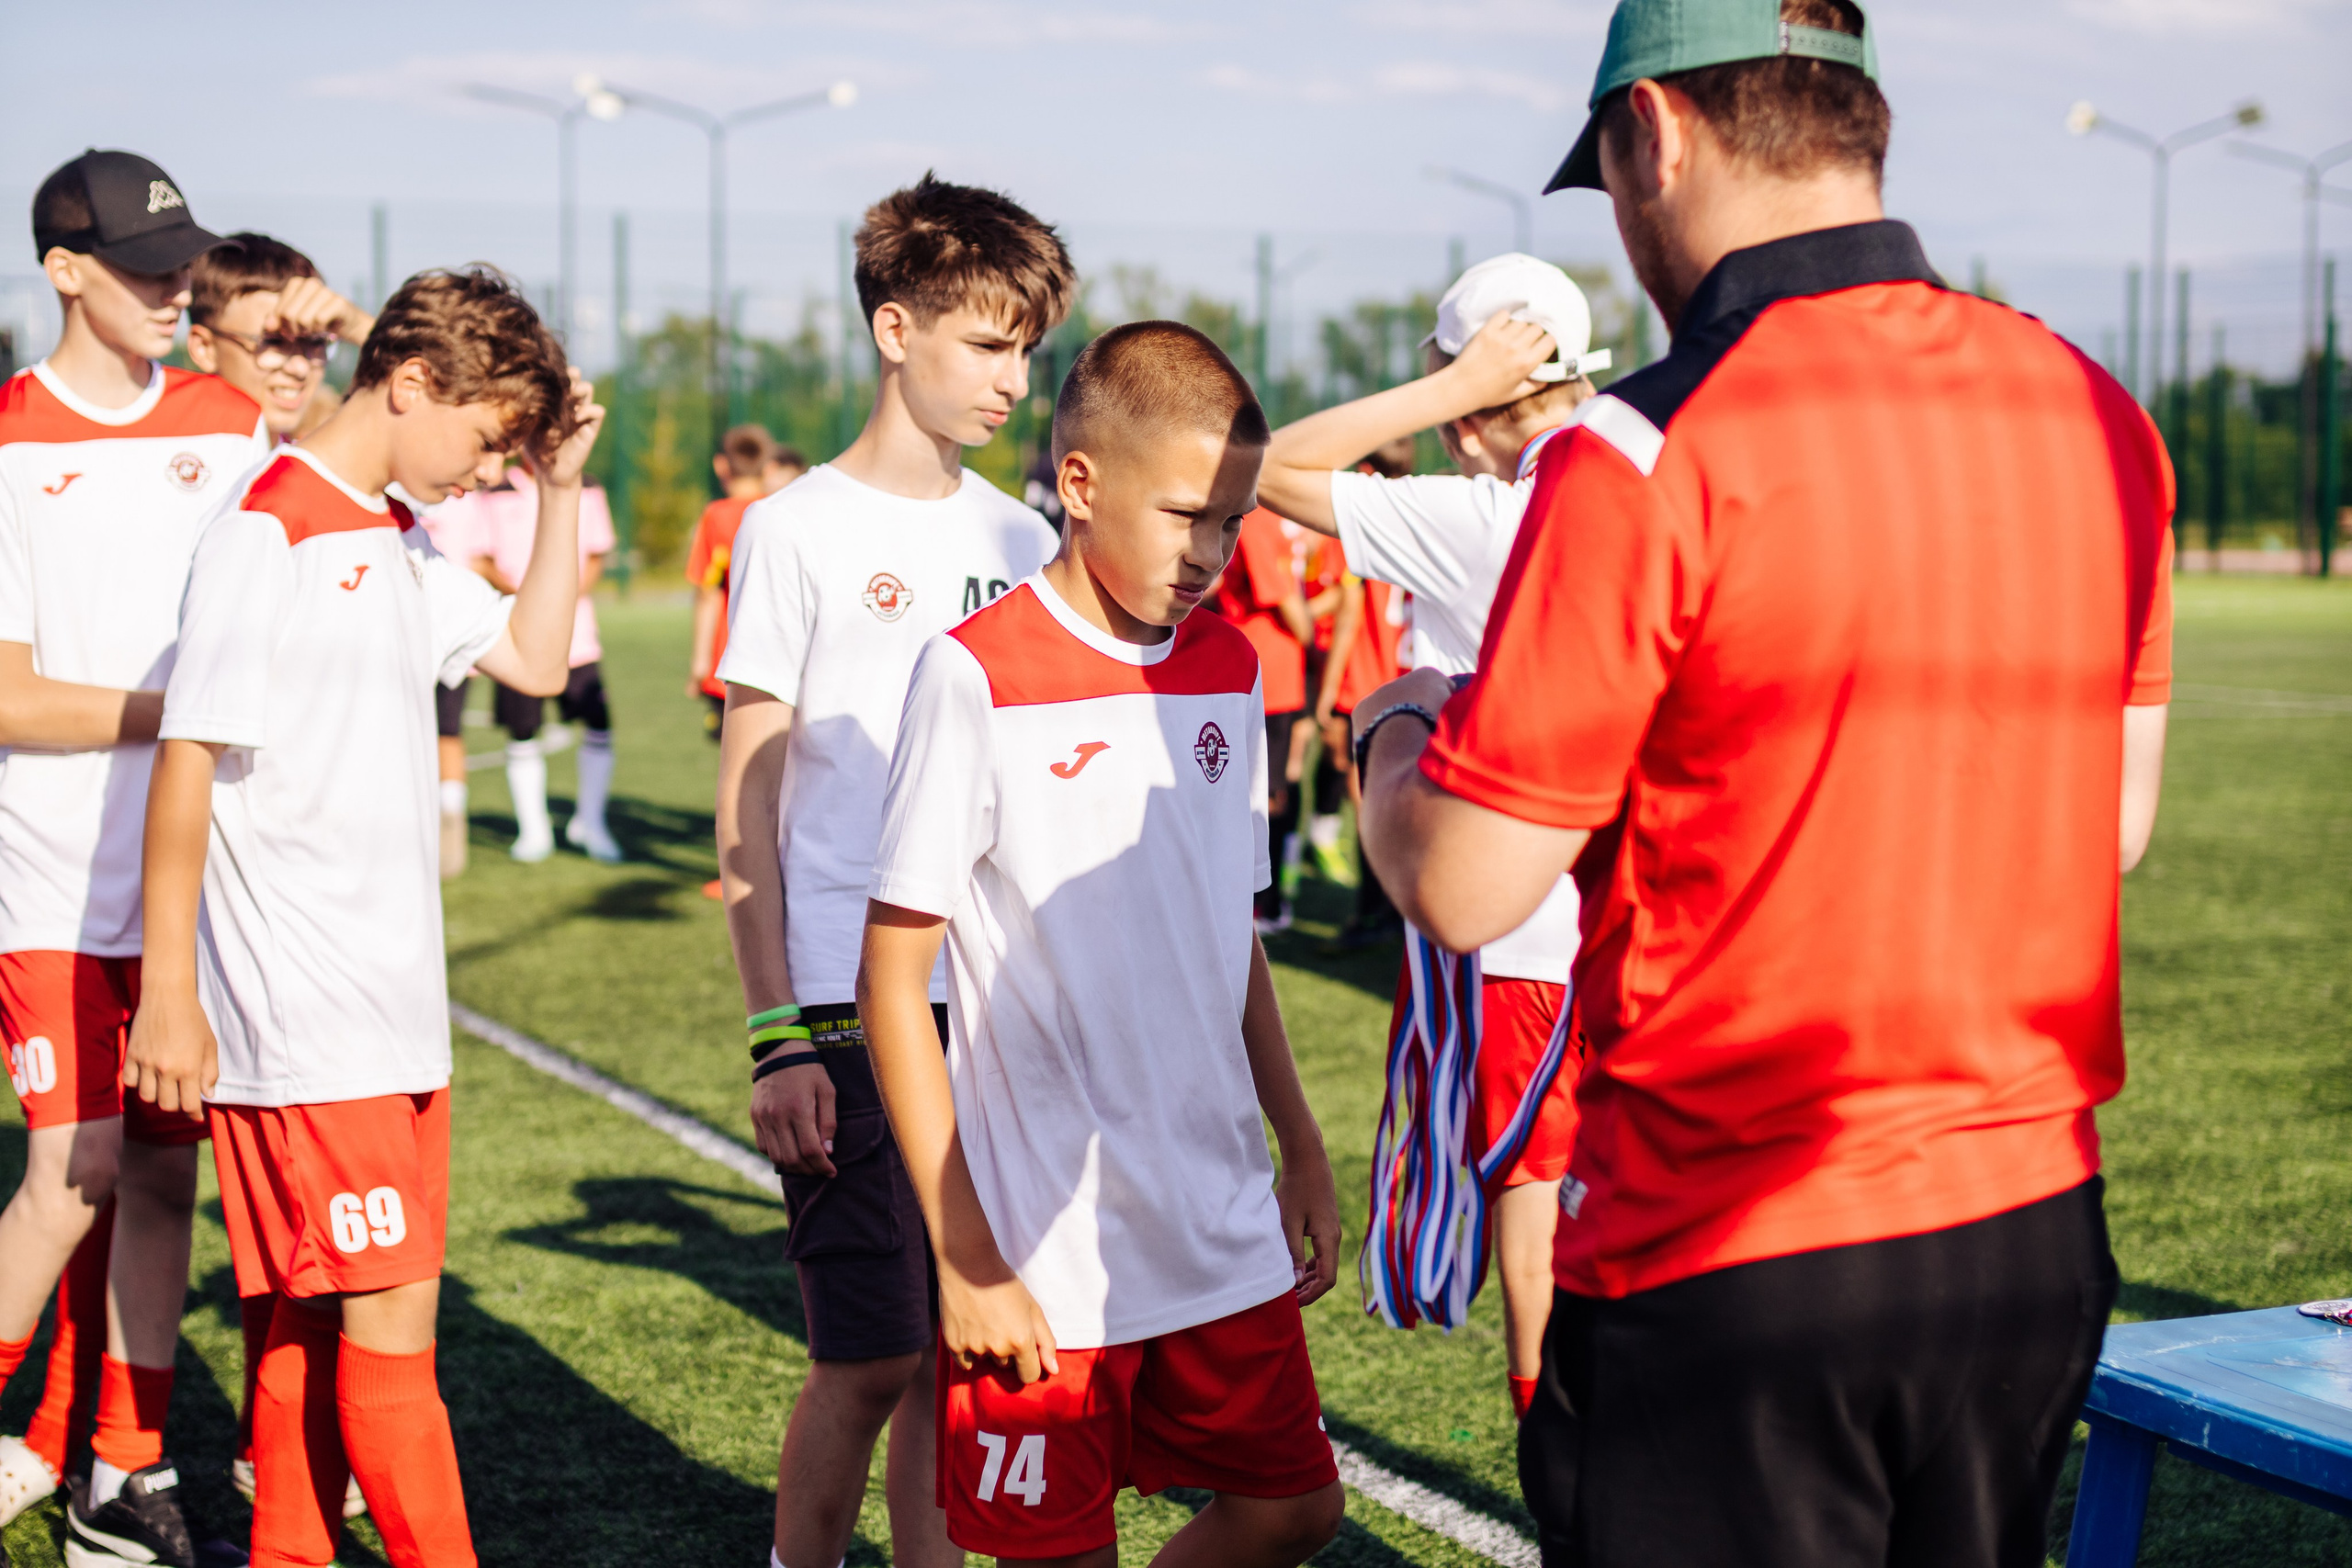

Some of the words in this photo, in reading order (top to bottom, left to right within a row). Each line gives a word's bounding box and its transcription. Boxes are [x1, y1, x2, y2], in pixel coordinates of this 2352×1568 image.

[810, 1021, 832, 1032] SURF
[11, 1035, 58, 1098] 30
[329, 1186, 407, 1254] 69
[977, 1430, 1046, 1506] 74
